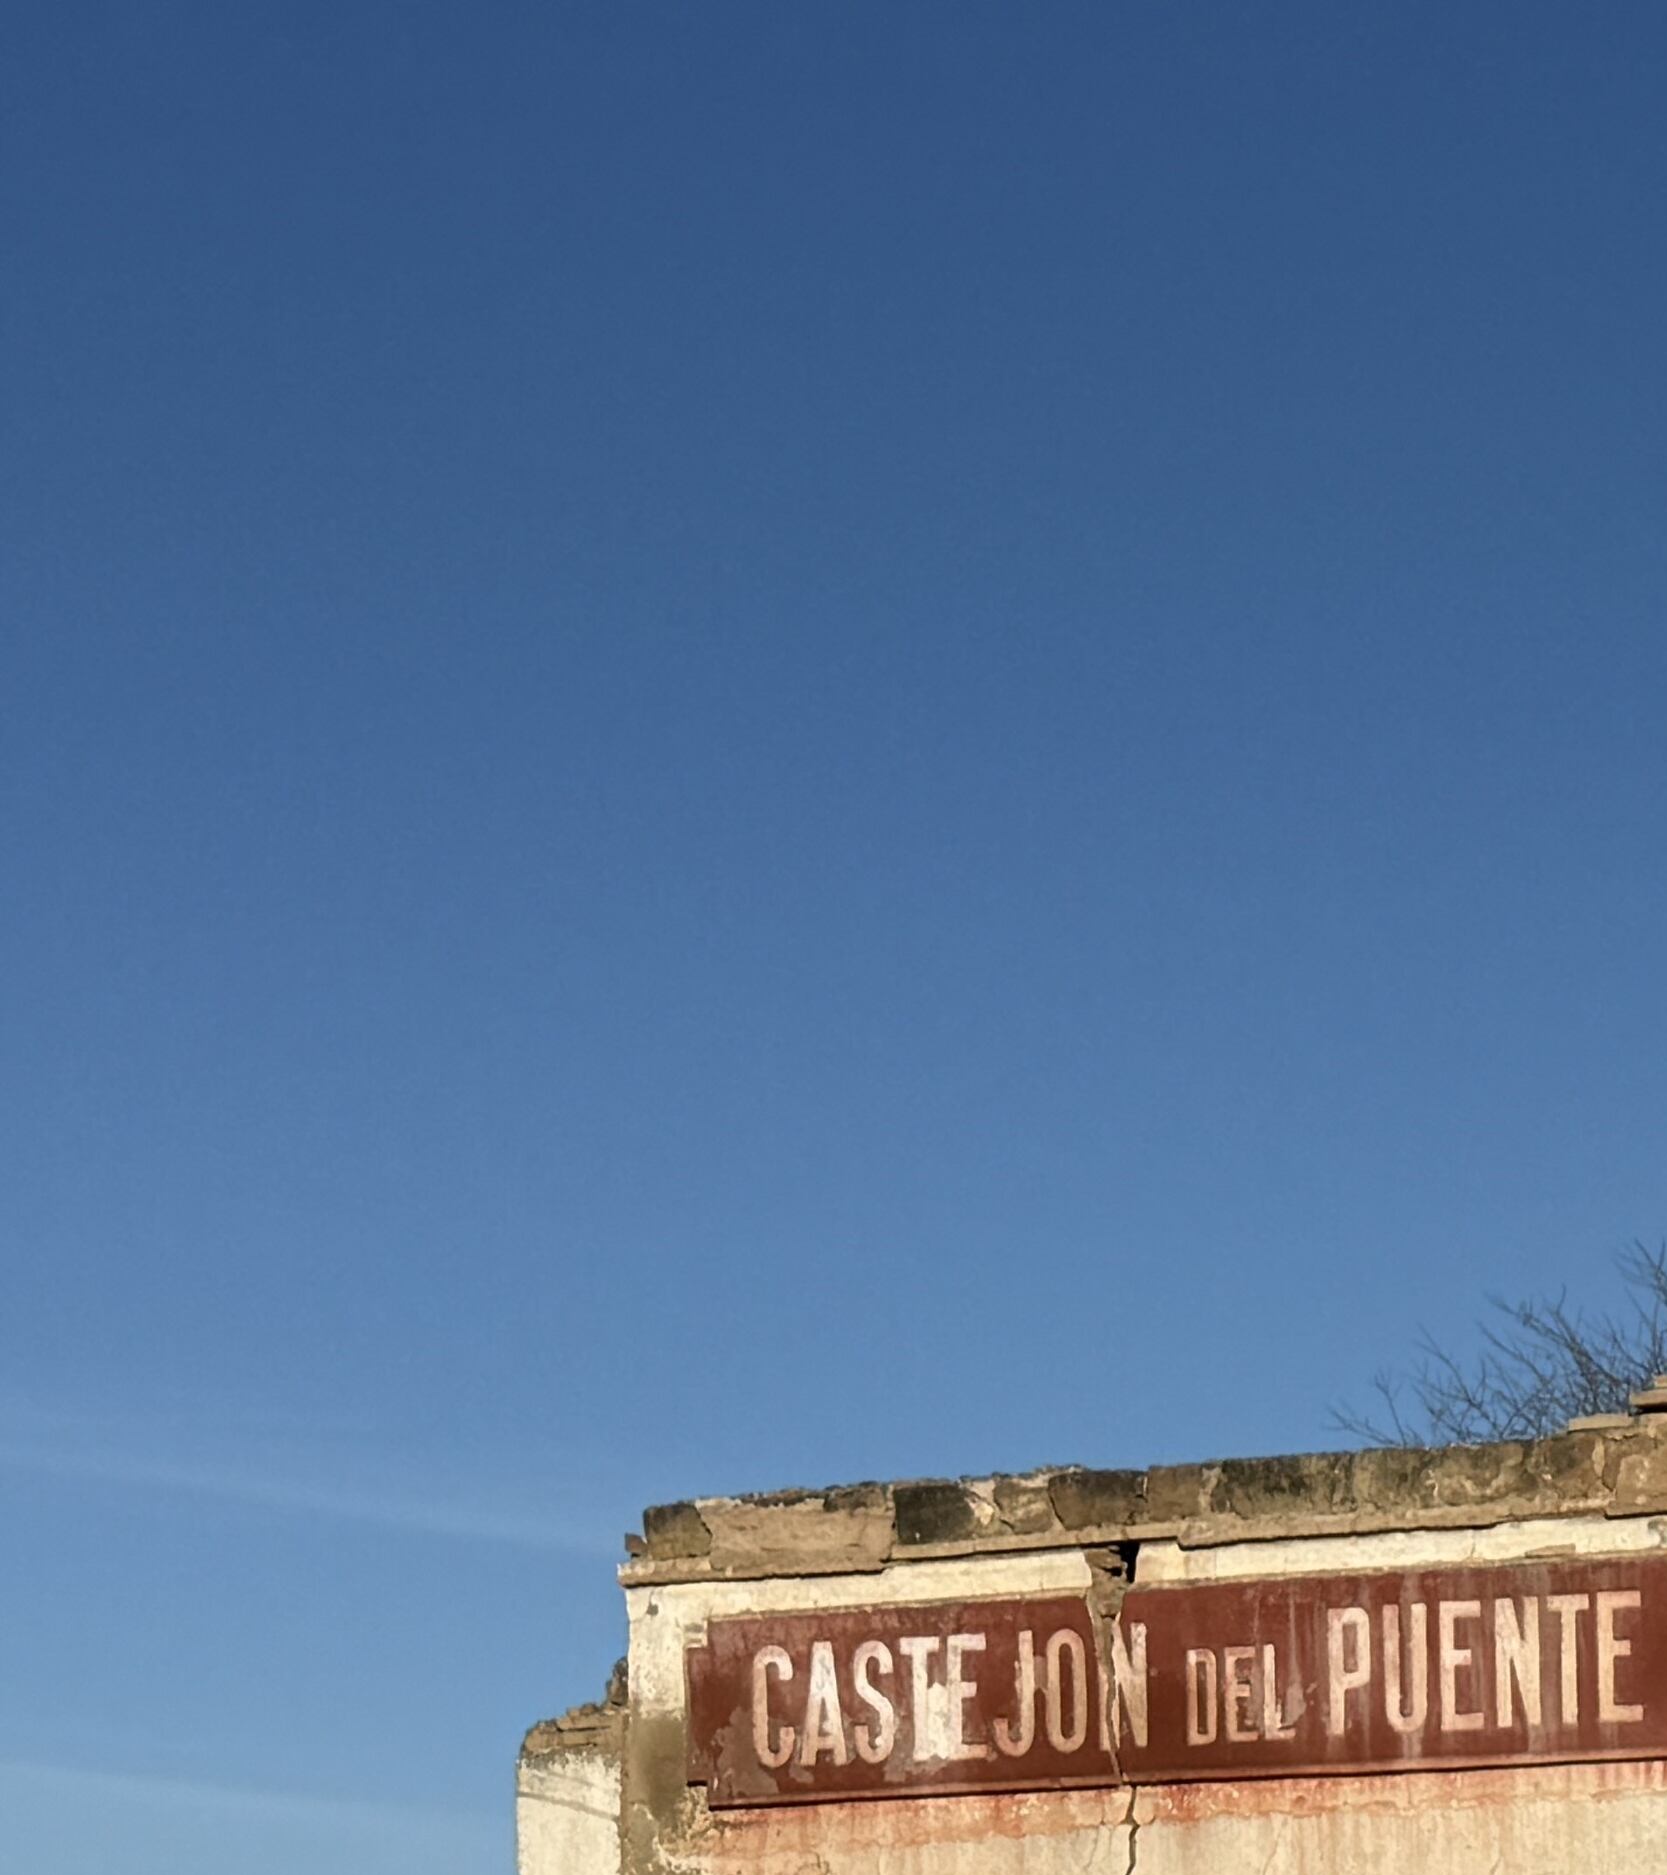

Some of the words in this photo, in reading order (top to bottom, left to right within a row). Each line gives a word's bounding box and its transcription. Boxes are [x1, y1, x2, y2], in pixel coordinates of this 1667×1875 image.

[751, 1621, 1149, 1769] CASTEJON
[1187, 1644, 1294, 1747] DEL
[1326, 1590, 1645, 1738] PUENTE
